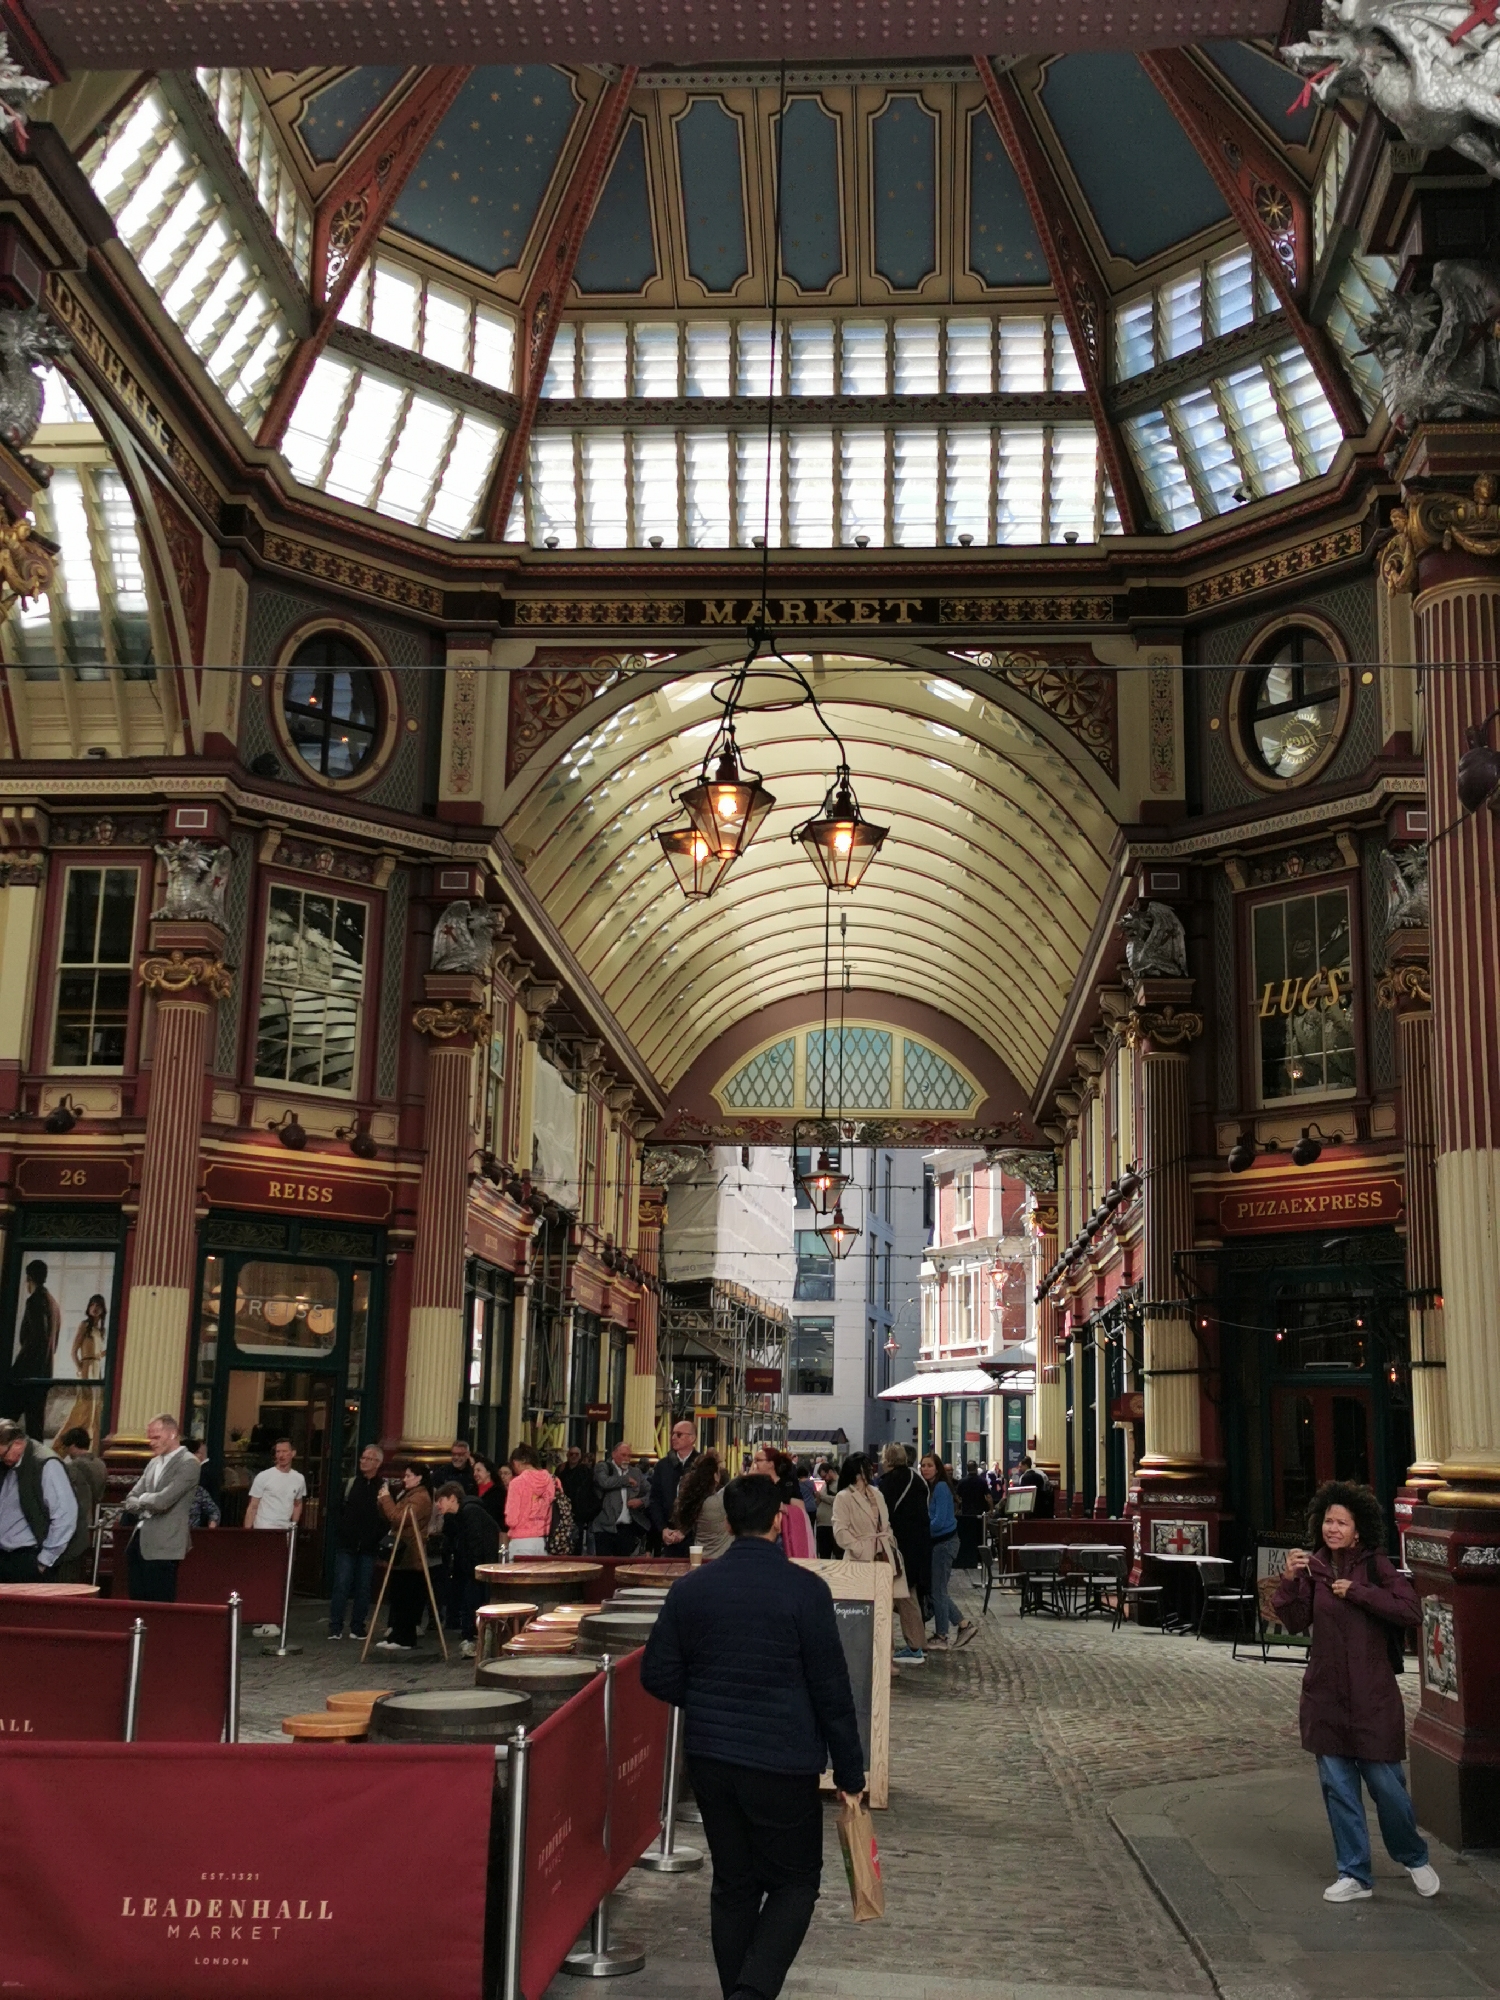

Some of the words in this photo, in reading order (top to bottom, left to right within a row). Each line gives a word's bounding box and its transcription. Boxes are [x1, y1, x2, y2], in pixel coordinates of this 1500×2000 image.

[701, 600, 923, 624] MARKET
[60, 1170, 86, 1186] 26
[269, 1181, 333, 1203] REISS
[1237, 1191, 1383, 1218] PIZZAEXPRESS
[249, 1300, 324, 1319] REISS
[201, 1872, 260, 1881] EST.1321
[121, 1896, 333, 1920] LEADENHALL
[167, 1924, 282, 1940] MARKET
[194, 1957, 250, 1966] LONDON
